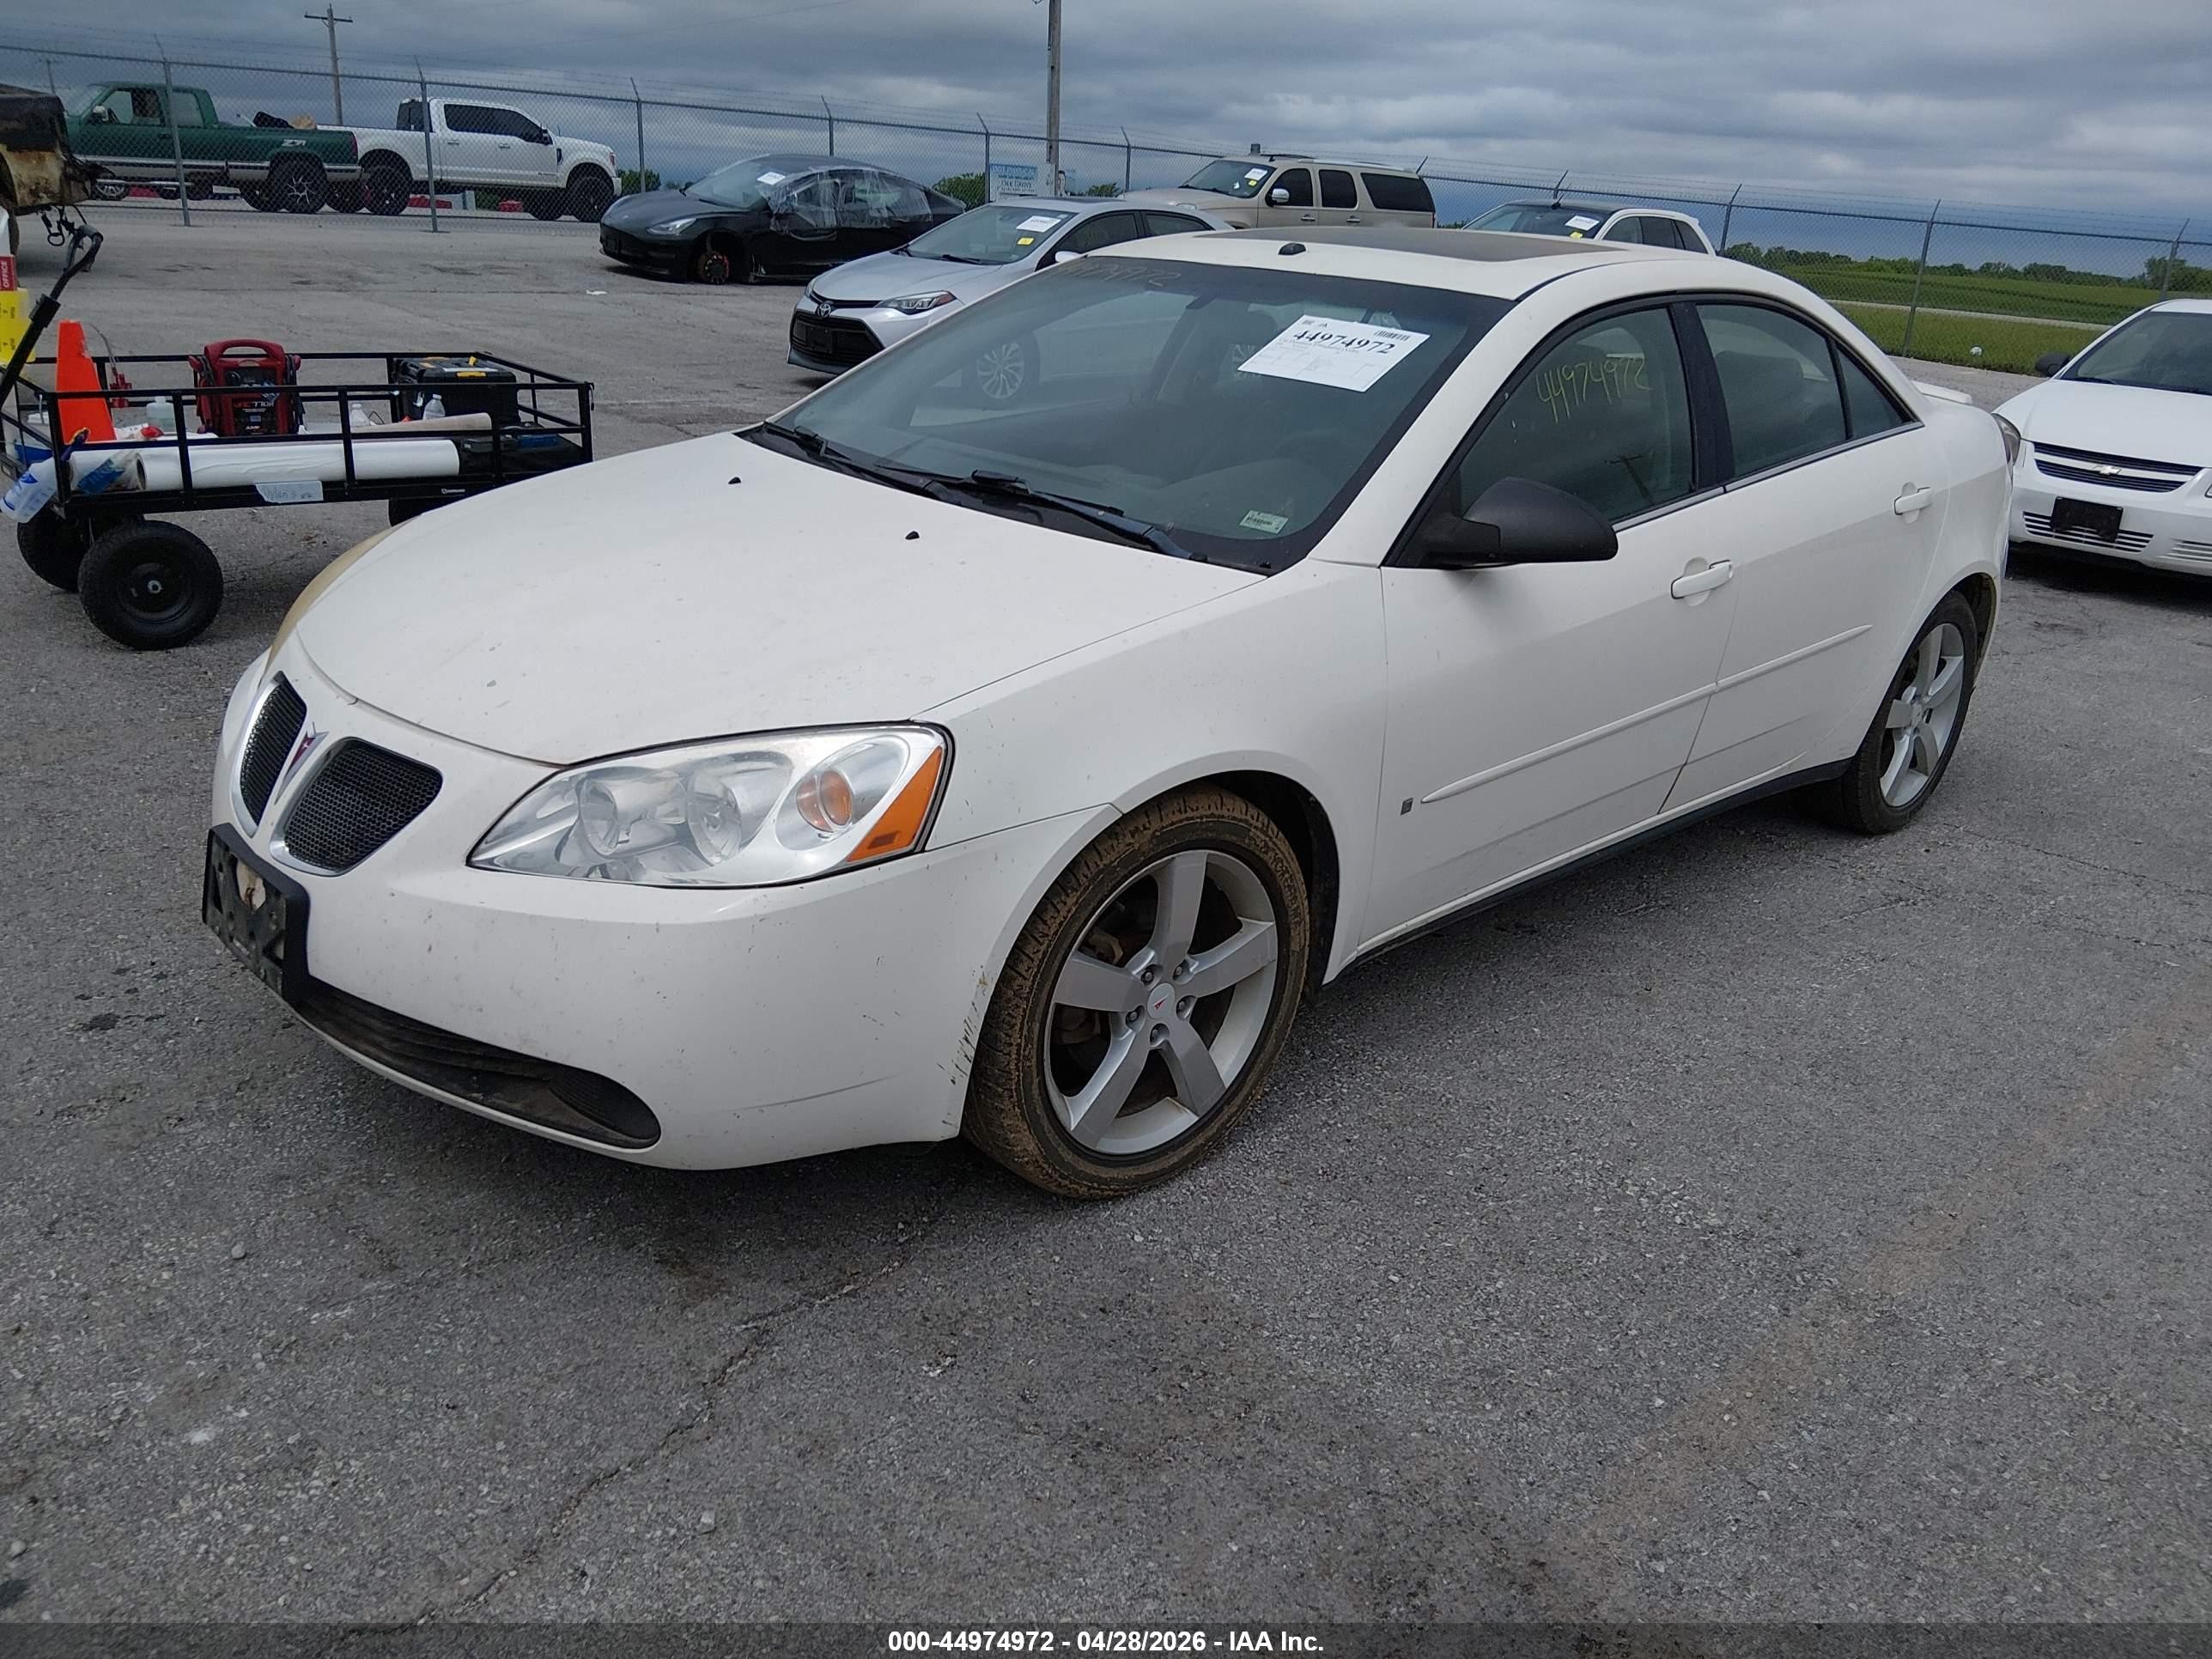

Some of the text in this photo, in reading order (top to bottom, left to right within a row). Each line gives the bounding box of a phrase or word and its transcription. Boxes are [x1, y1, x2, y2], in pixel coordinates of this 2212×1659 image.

[0, 260, 10, 289] OFFICE
[1293, 330, 1395, 354] 44974972
[1534, 356, 1654, 424] 44974972
